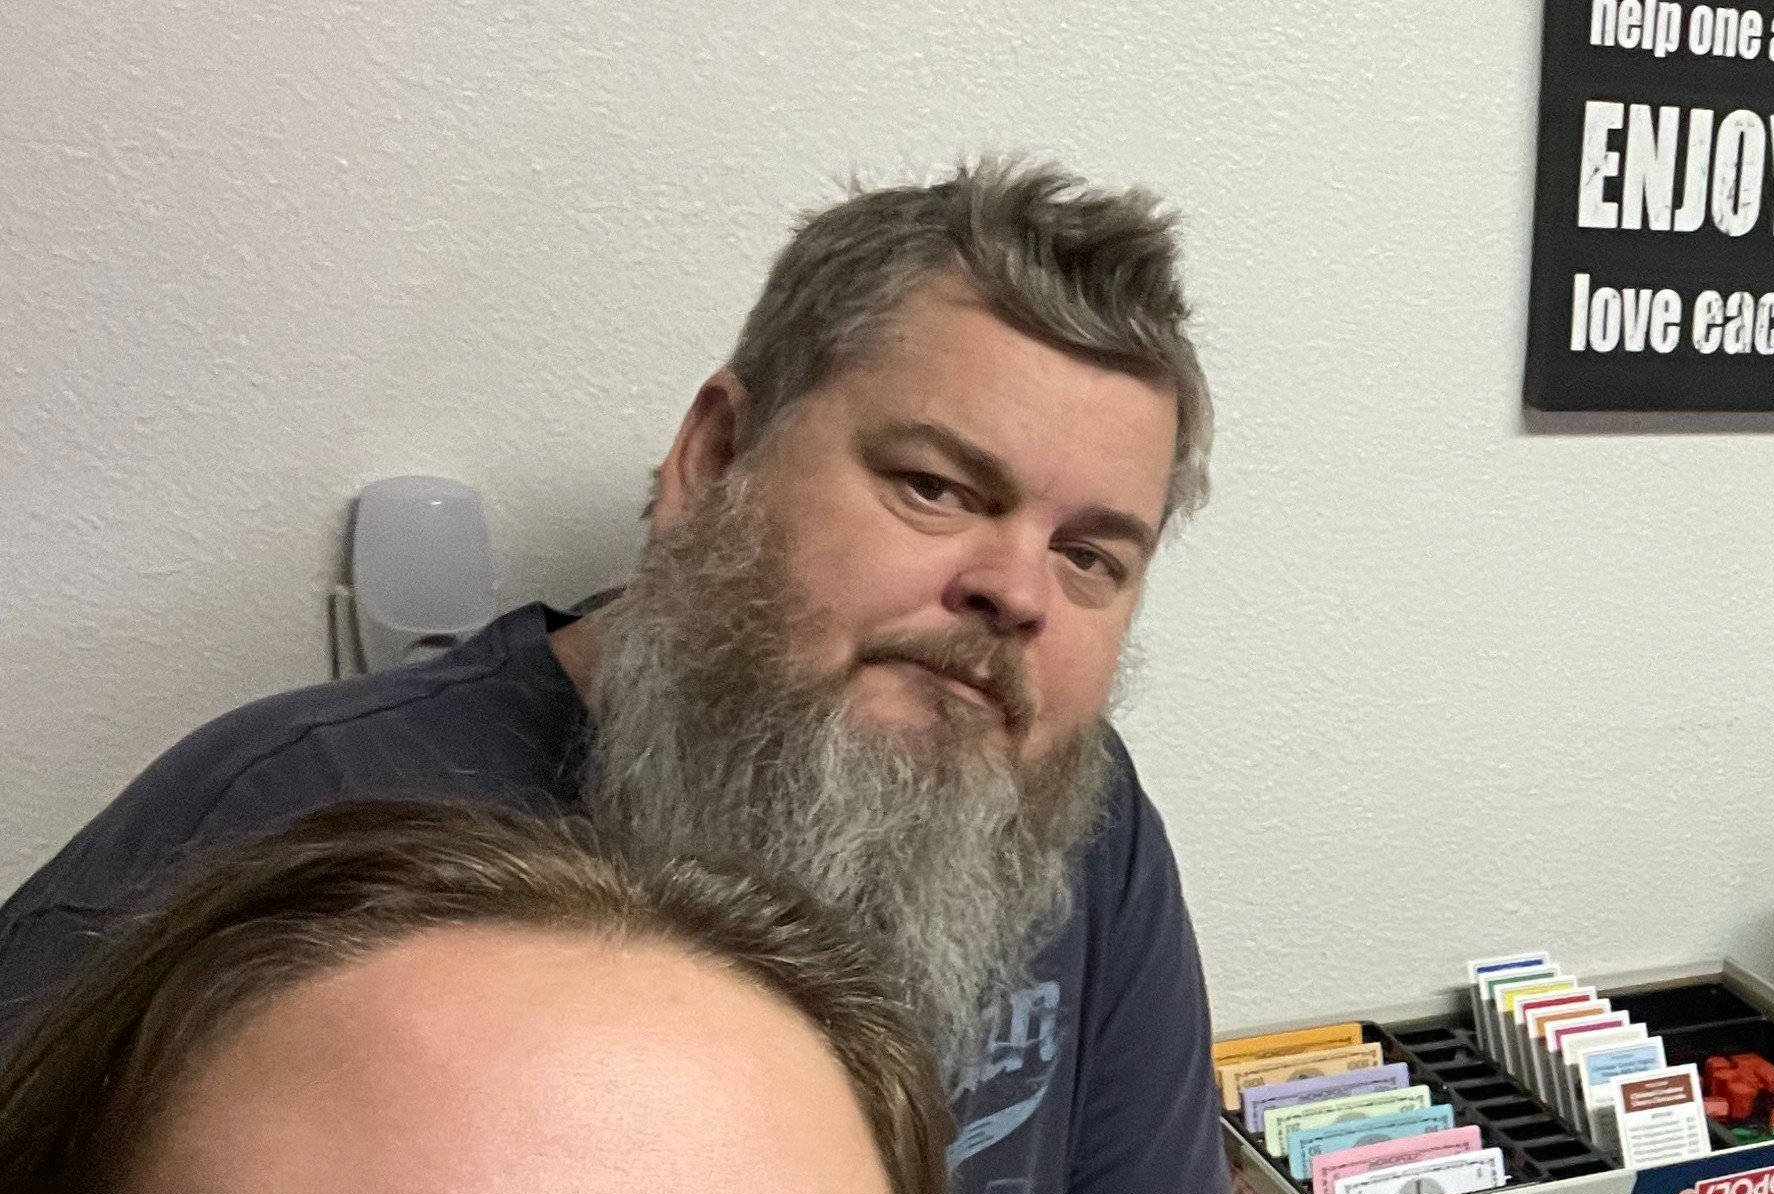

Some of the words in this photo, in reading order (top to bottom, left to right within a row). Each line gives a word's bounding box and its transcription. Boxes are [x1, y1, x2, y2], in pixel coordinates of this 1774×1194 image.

[1589, 0, 1681, 58] help
[1688, 5, 1763, 60] one
[1570, 272, 1682, 354] love
